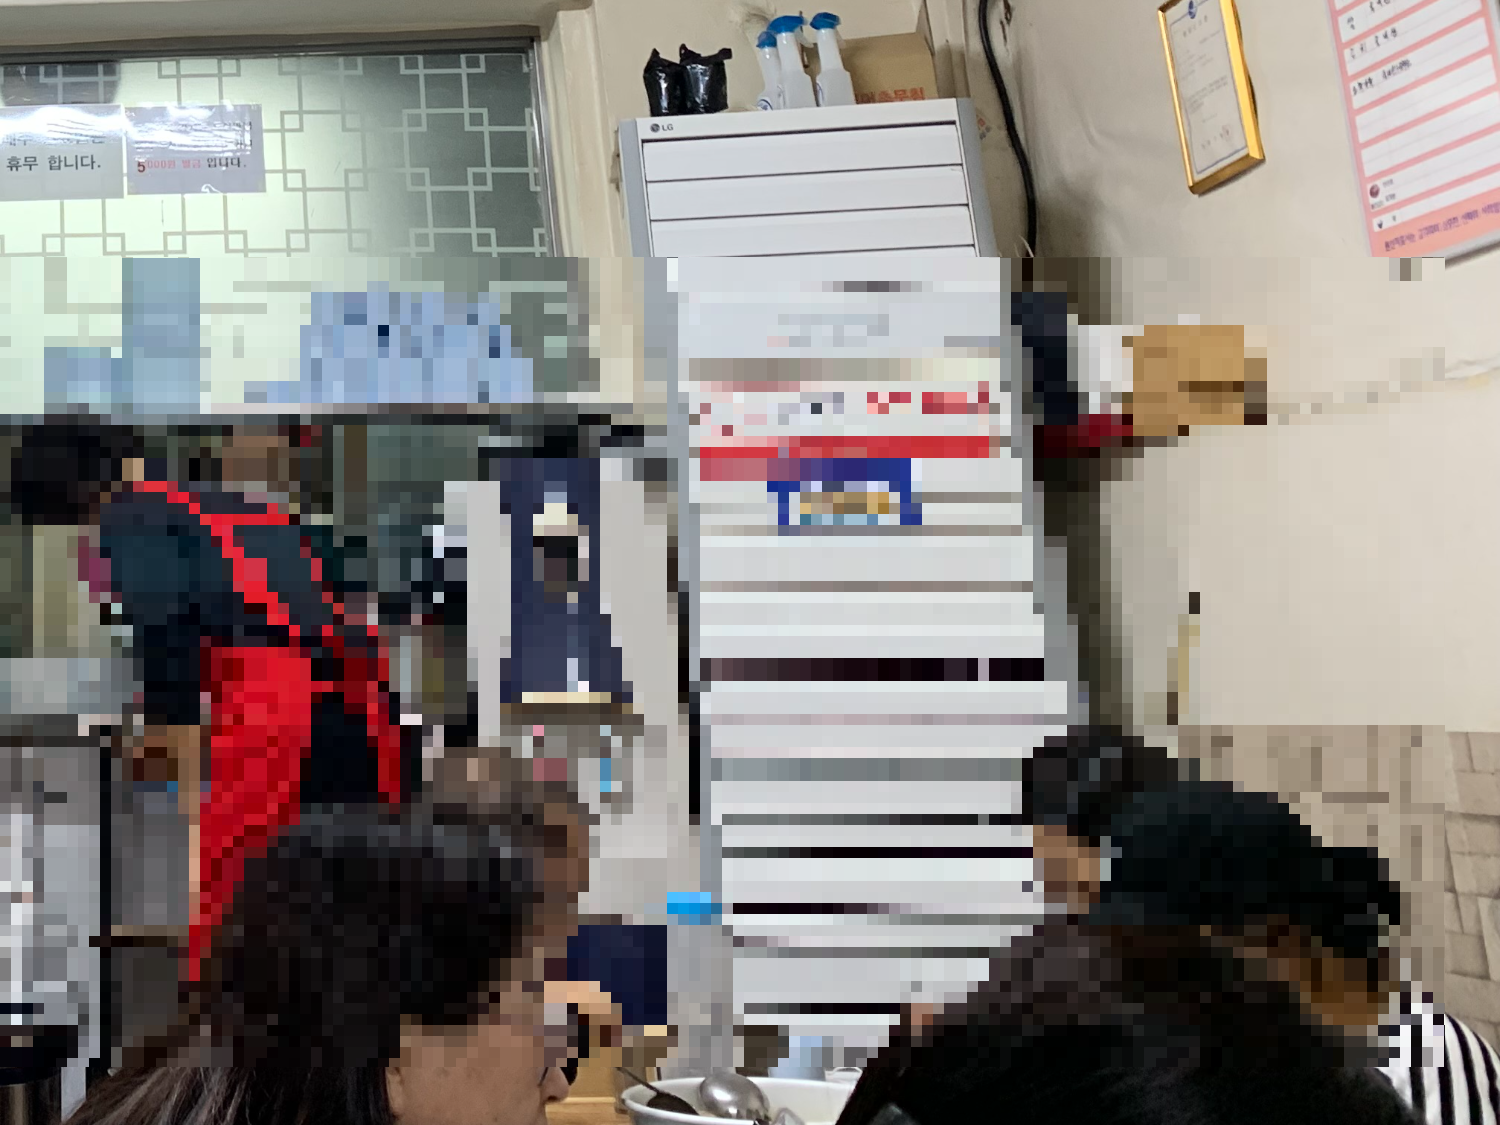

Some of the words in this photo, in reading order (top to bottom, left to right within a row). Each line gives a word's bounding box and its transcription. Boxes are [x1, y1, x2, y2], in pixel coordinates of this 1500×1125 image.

[661, 123, 674, 132] LG
[6, 155, 39, 172] 휴무
[47, 154, 102, 171] 합니다.
[136, 159, 176, 173] 5000원
[181, 159, 202, 169] 벌금
[206, 156, 248, 169] 입니다.
